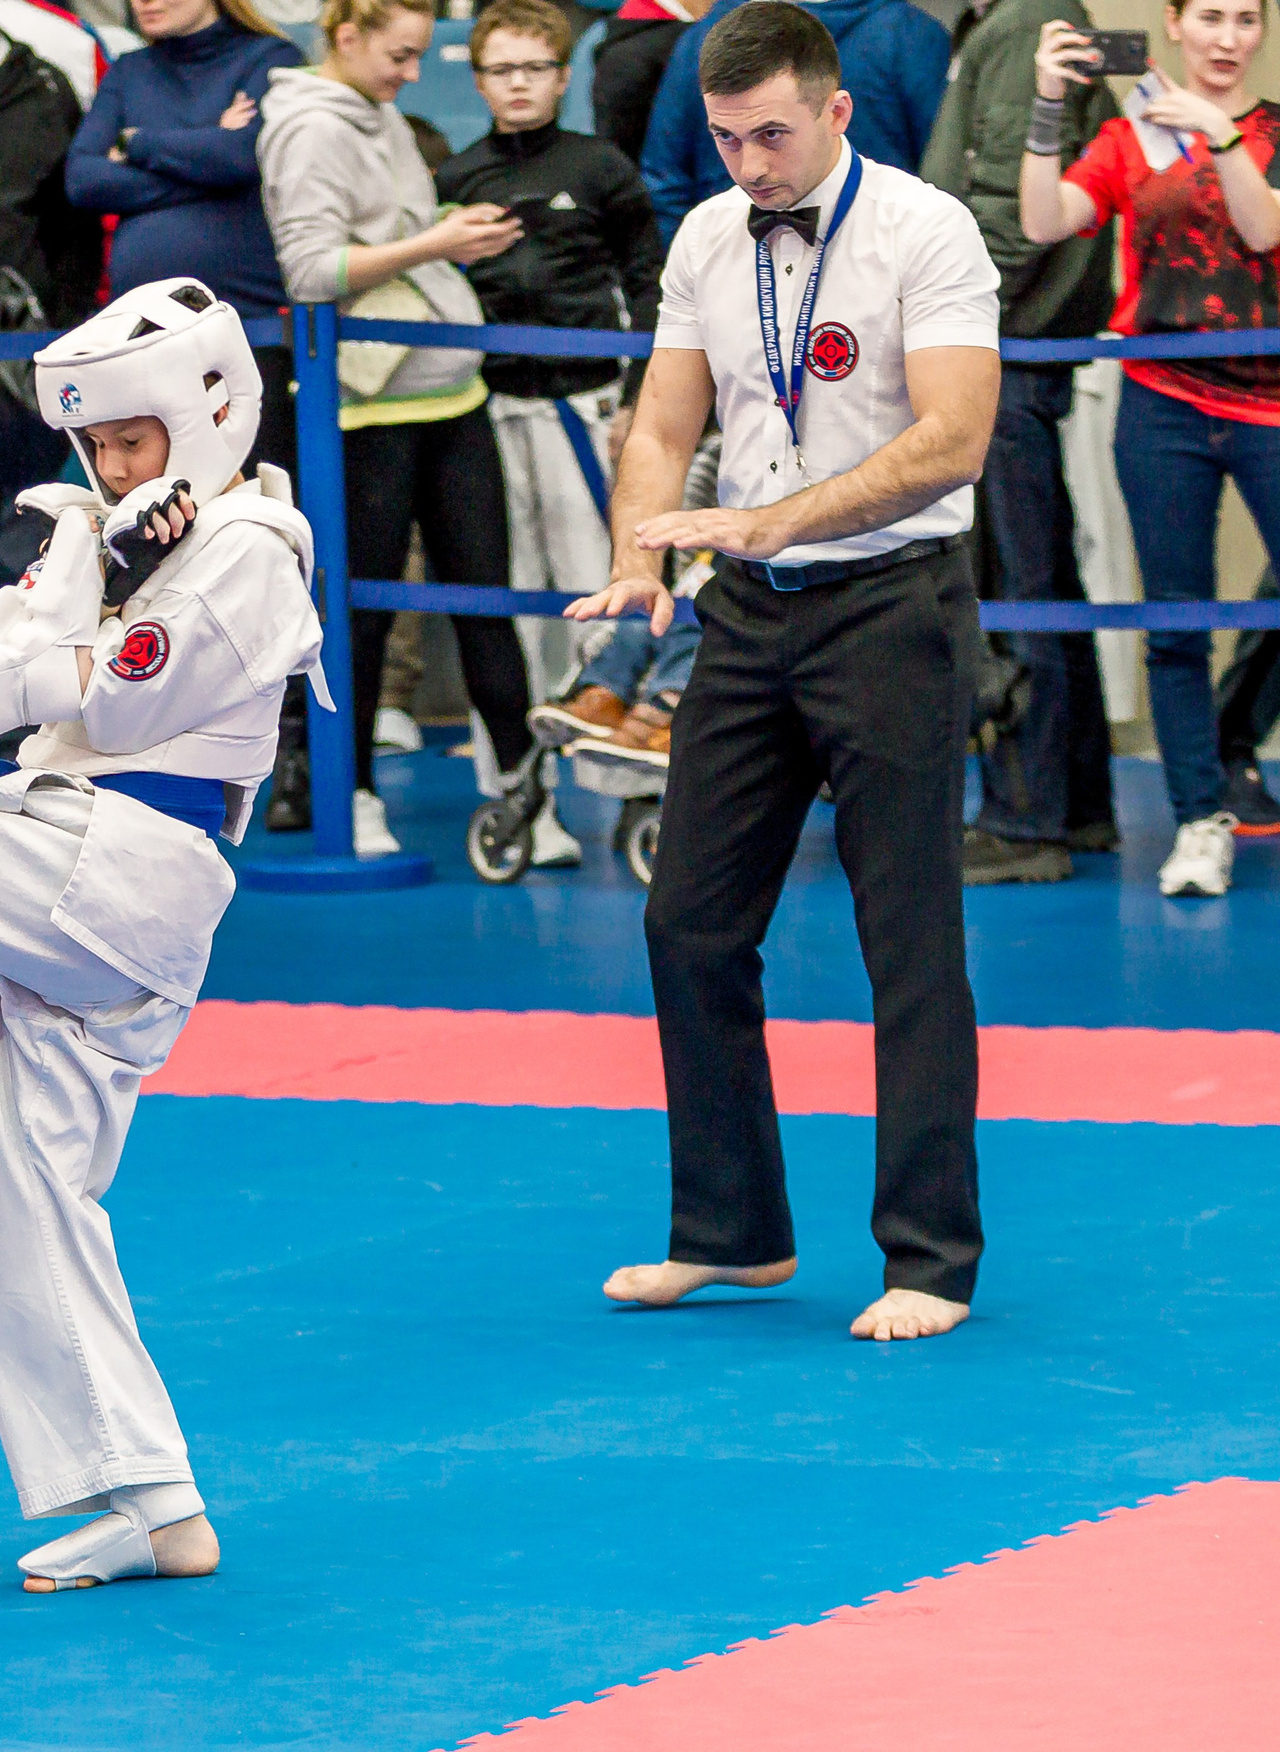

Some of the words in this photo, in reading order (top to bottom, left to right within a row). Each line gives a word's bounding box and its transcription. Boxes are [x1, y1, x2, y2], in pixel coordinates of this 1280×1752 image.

[758, 267, 774, 318] КИОКУШИН
[798, 275, 818, 327] КИОКУШИН
[762, 319, 781, 373] ФЕДЕРАЦИЯ
[793, 329, 807, 366] РОССИИ
